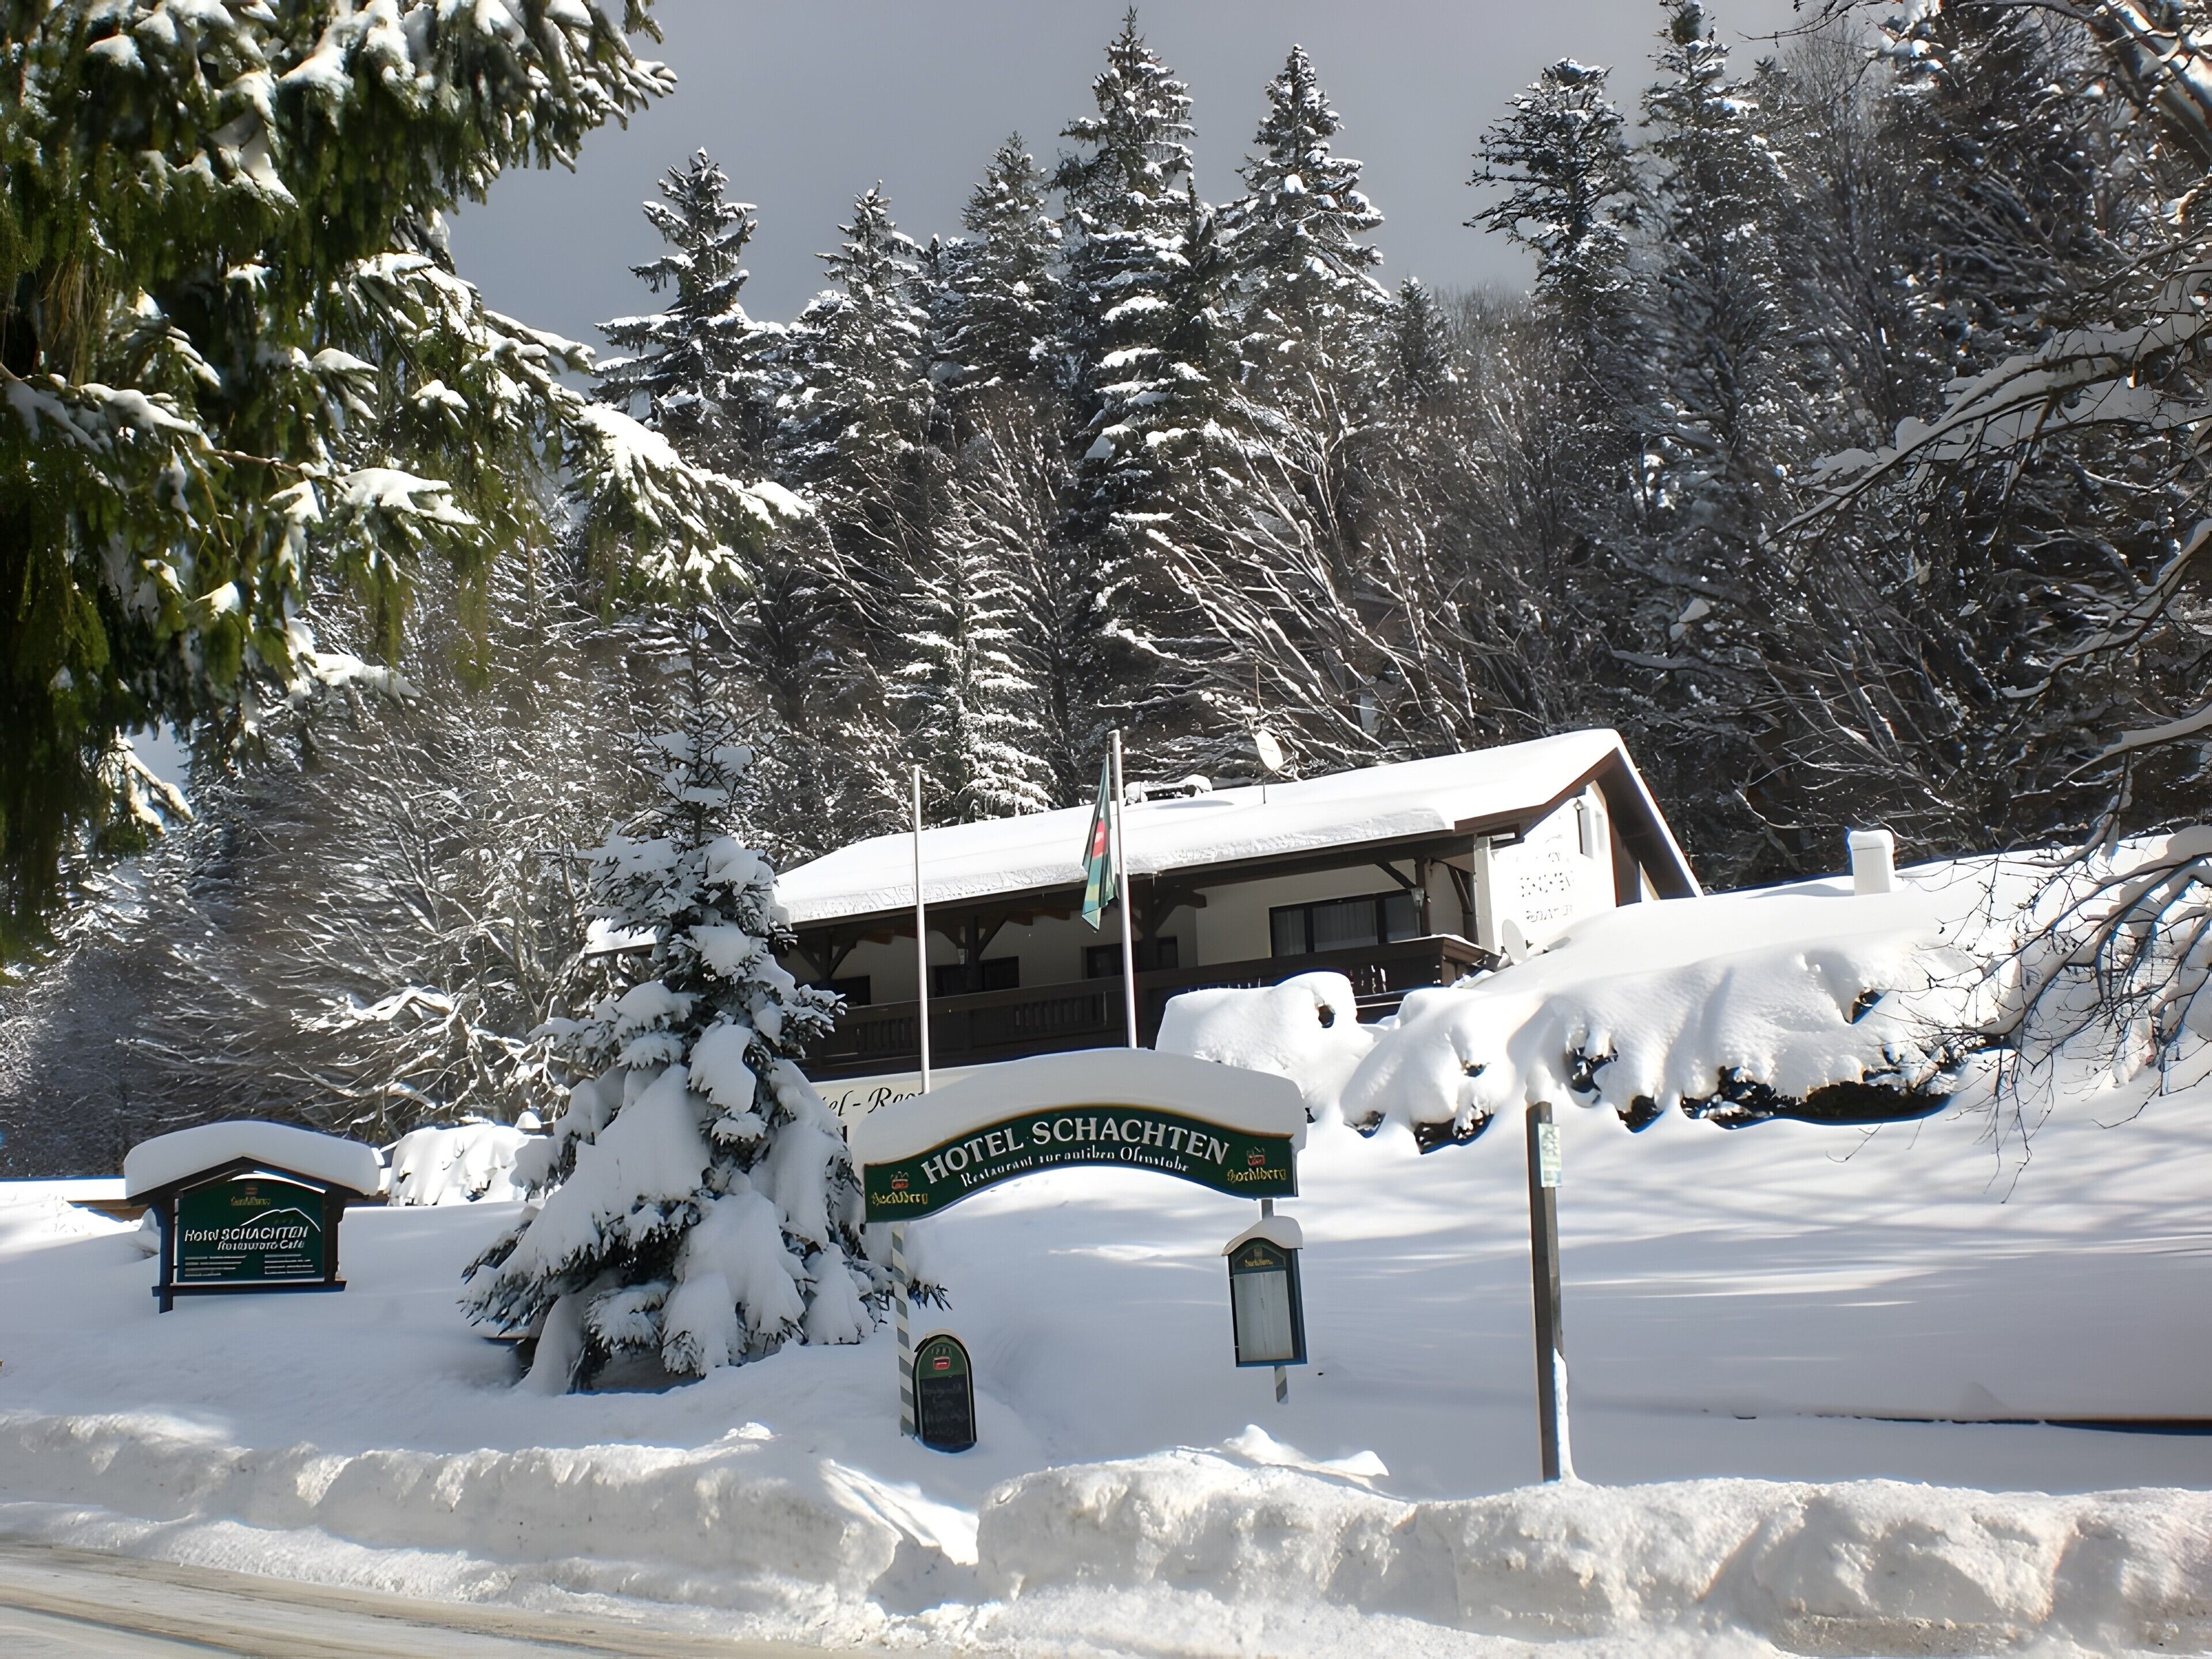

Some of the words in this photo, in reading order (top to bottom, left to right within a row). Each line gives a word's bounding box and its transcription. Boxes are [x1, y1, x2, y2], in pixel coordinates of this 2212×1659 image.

[921, 1128, 1024, 1184] HOTEL
[1032, 1117, 1230, 1165] SCHACHTEN
[960, 1156, 1033, 1187] Restaurant
